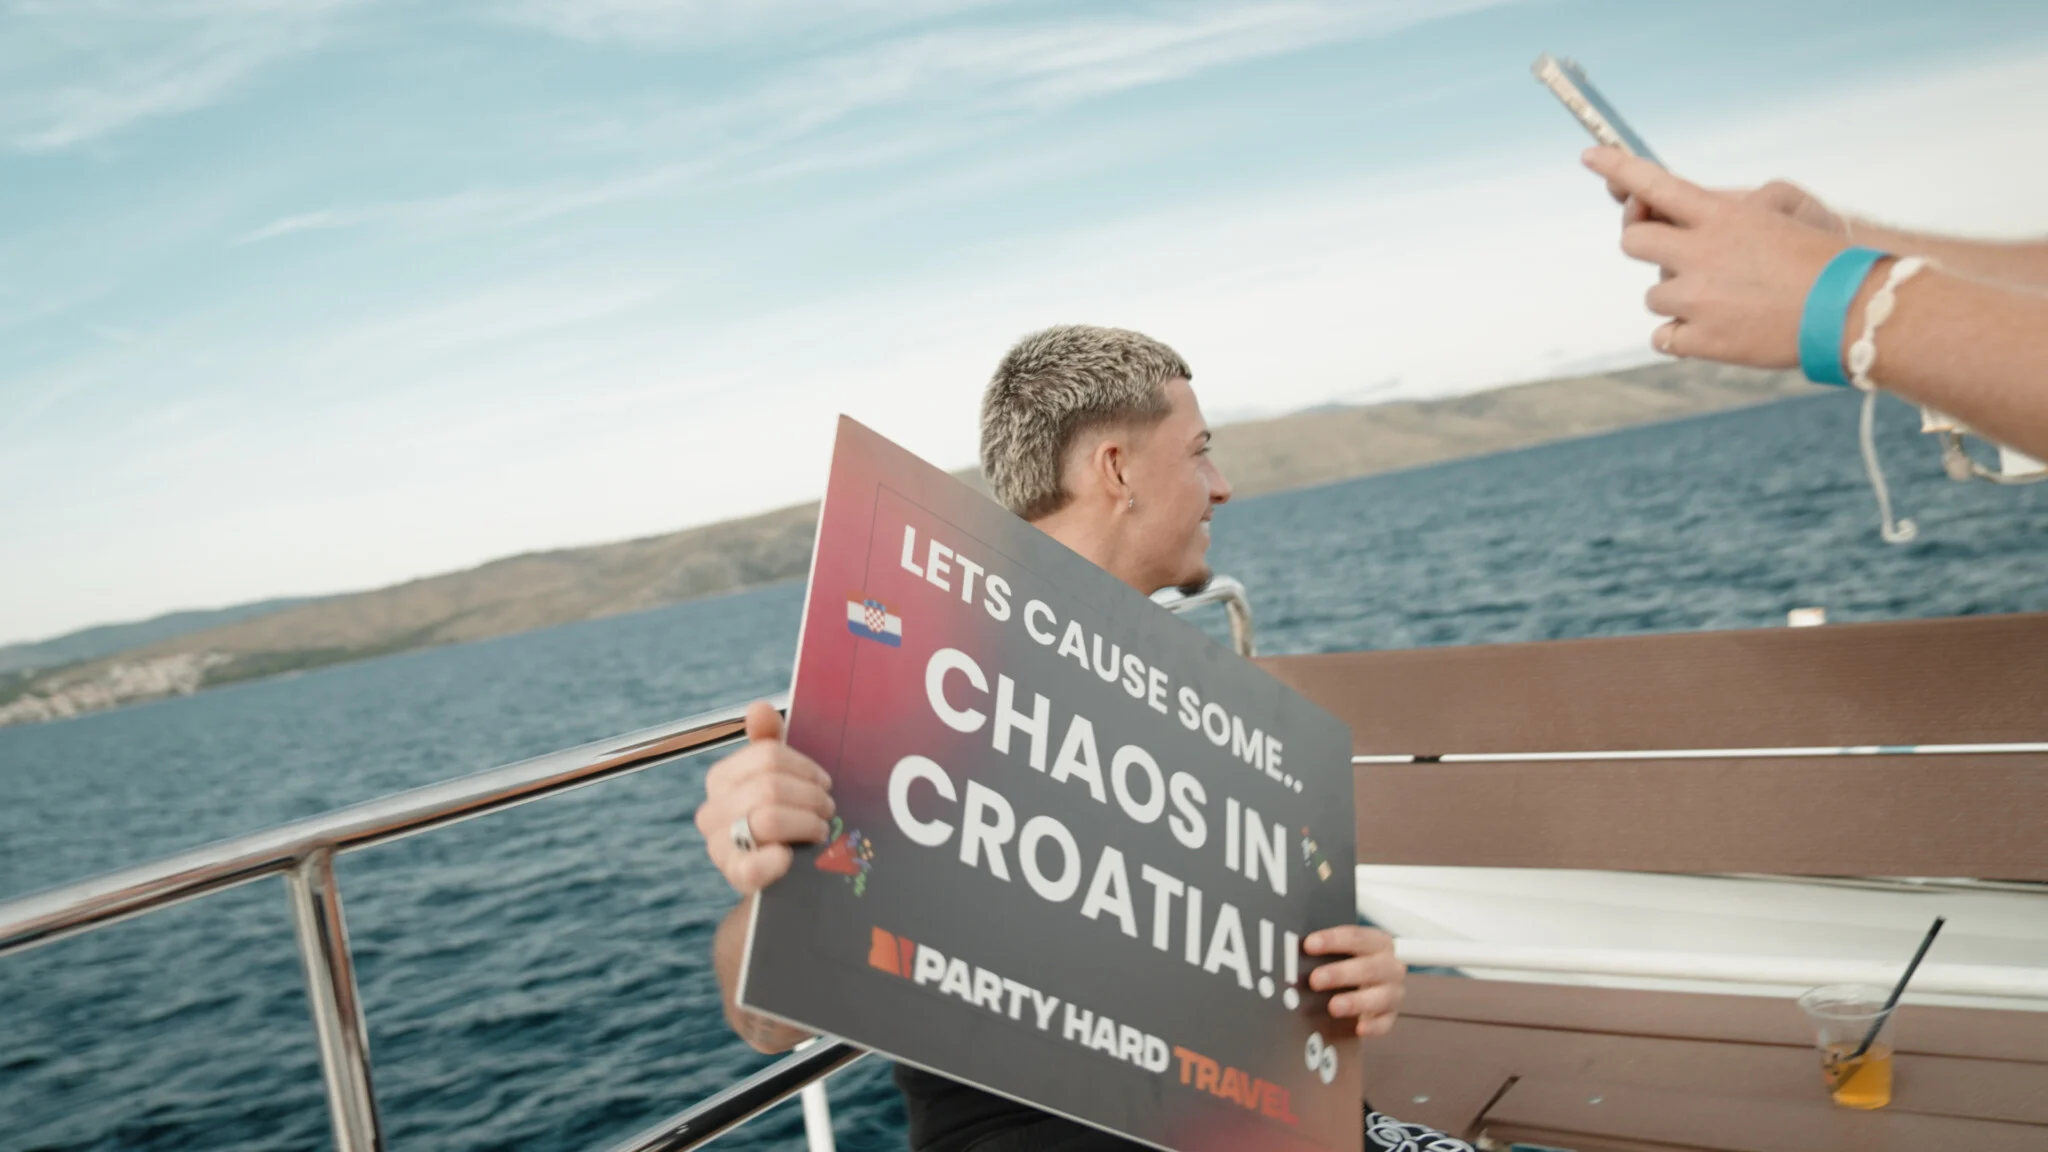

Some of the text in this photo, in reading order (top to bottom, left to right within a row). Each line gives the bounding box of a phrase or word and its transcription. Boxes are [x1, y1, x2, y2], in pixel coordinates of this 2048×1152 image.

[900, 524, 1304, 793] LETS CAUSE SOME..
[925, 648, 1288, 896] CHAOS IN
[888, 755, 1300, 1010] CROATIA!!
[913, 943, 1299, 1126] PARTY HARD TRAVEL
